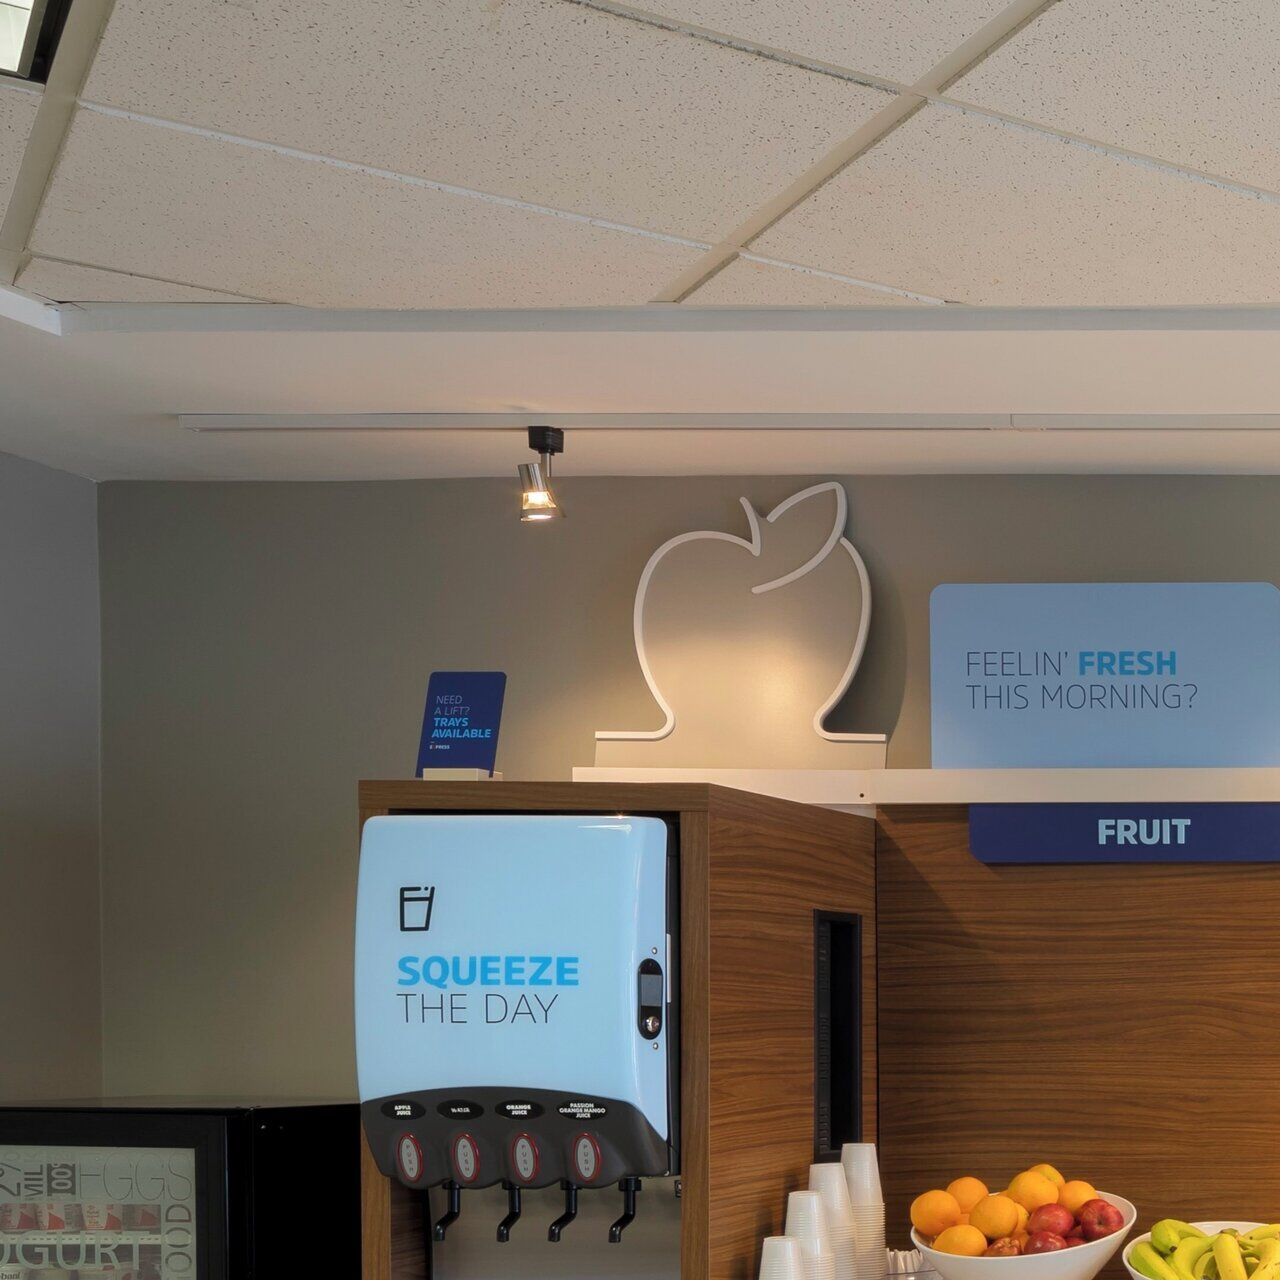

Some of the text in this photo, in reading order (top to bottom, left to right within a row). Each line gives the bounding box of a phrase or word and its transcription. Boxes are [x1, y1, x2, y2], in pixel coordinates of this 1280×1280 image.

[965, 650, 1177, 677] FEELIN' FRESH
[434, 705, 471, 715] A LIFT?
[436, 695, 463, 704] NEED
[965, 683, 1198, 710] THIS MORNING?
[431, 729, 491, 738] AVAILABLE
[434, 717, 469, 727] TRAYS
[1097, 818, 1191, 845] FRUIT
[397, 956, 579, 989] SQUEEZE
[397, 993, 559, 1023] THE DAY
[0, 1230, 151, 1270] GURT
